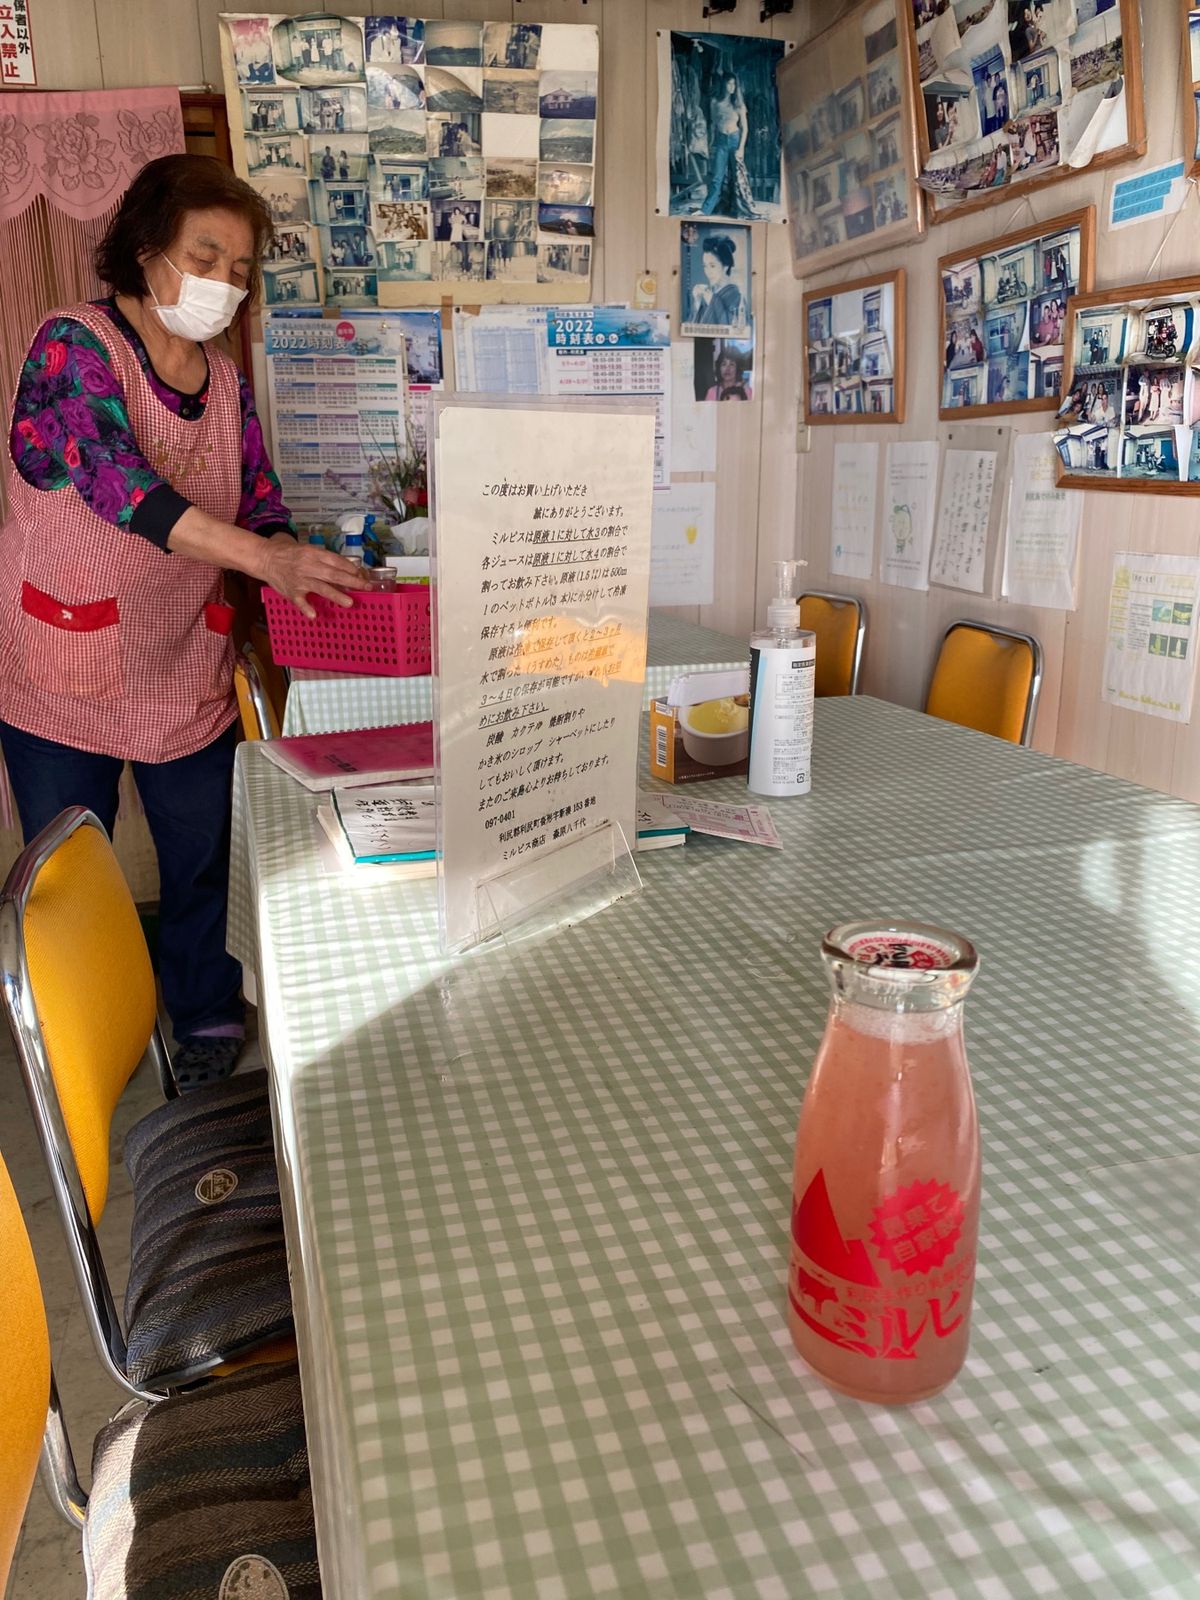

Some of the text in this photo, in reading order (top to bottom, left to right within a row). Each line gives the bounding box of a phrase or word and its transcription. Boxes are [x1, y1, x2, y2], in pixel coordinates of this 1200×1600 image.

[0, 5, 20, 77] 立入禁止
[556, 320, 594, 332] 2022
[271, 337, 347, 349] 2022時刻表
[555, 333, 594, 345] 時刻表
[482, 483, 587, 497] この度はお買い上げいただき
[533, 505, 624, 520] 誠にありがとうございます。
[492, 525, 628, 545] ミルピスは原液1に対して水3の割合で
[481, 545, 628, 570] 各ジュースは原液1に対して水4の割合で
[479, 702, 549, 727] めにお飲み下さい。
[511, 720, 543, 739] カクテル
[478, 717, 616, 770] かき氷のシロップ シャーベットにしたり
[480, 752, 564, 790] してもおいしく頂けます。
[484, 810, 516, 829] 097-0401
[502, 834, 546, 860] ミルピス商店
